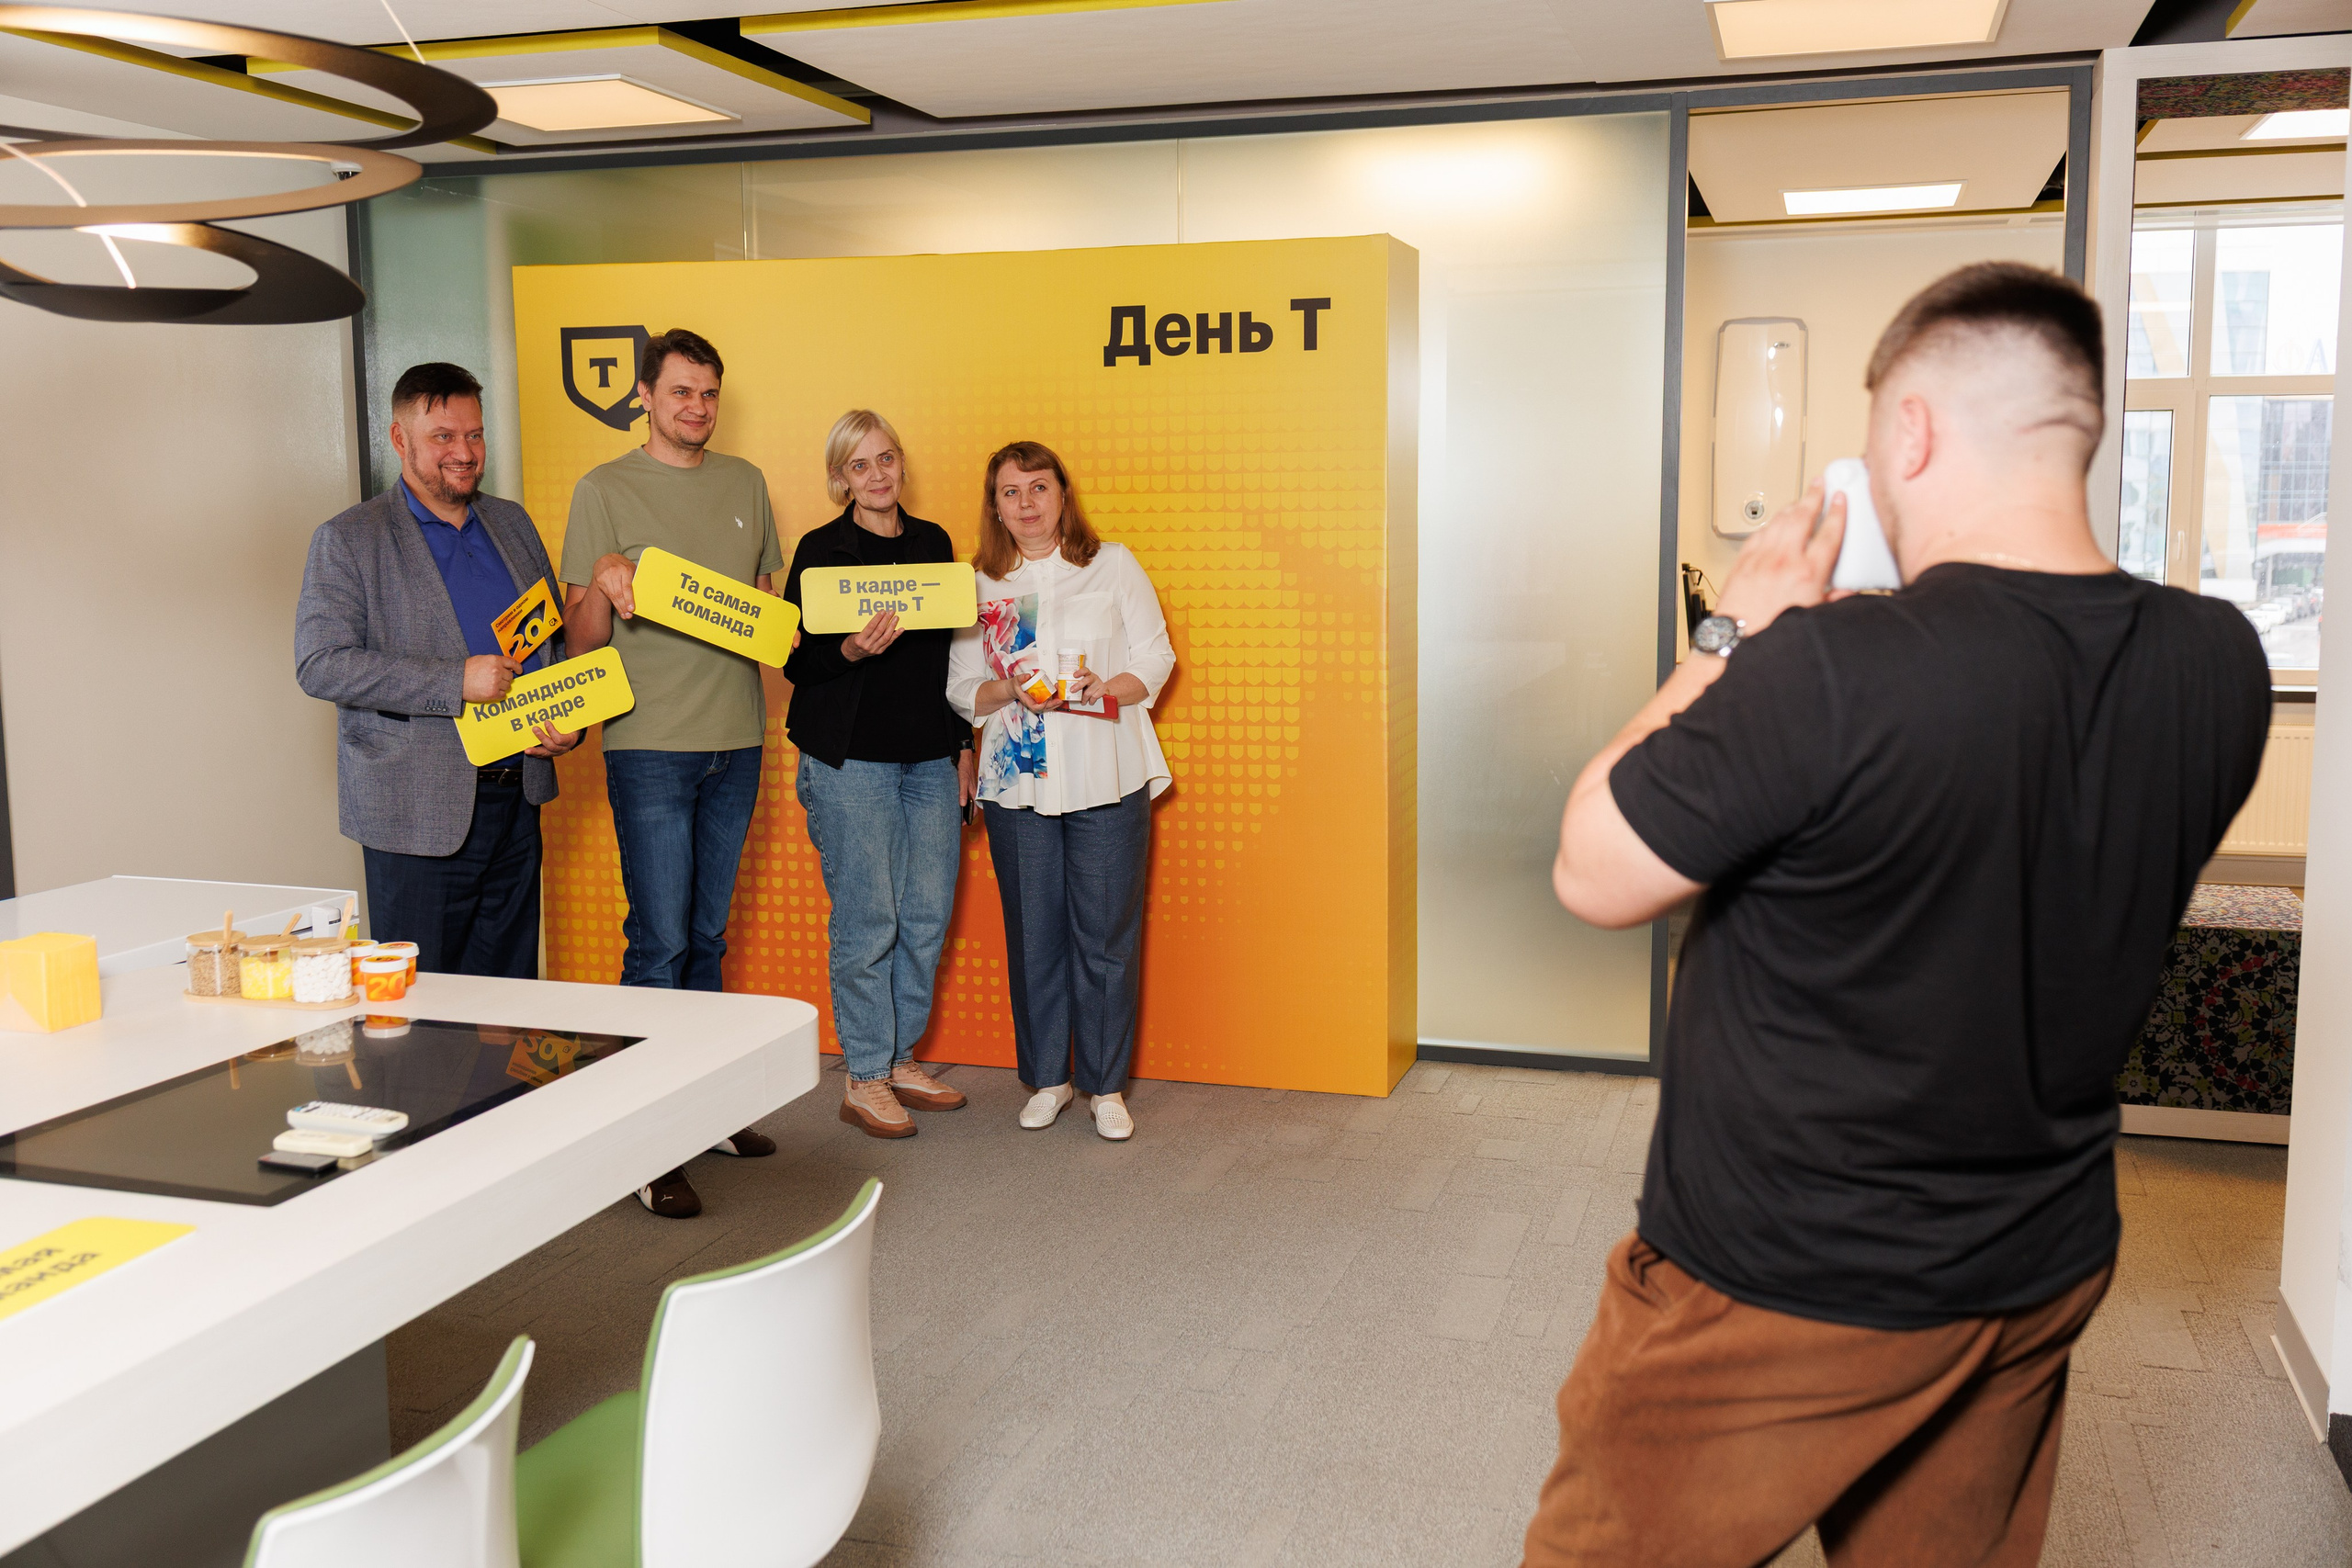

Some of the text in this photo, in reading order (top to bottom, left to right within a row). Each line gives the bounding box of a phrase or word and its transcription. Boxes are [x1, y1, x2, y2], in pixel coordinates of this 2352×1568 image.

[1103, 298, 1331, 367] День Т
[680, 572, 762, 619] Та самая
[839, 579, 852, 594] В
[856, 579, 917, 596] кадре
[858, 596, 924, 616] День Т
[672, 595, 755, 638] команда
[472, 666, 607, 723] Командность
[510, 694, 585, 732] в кадре
